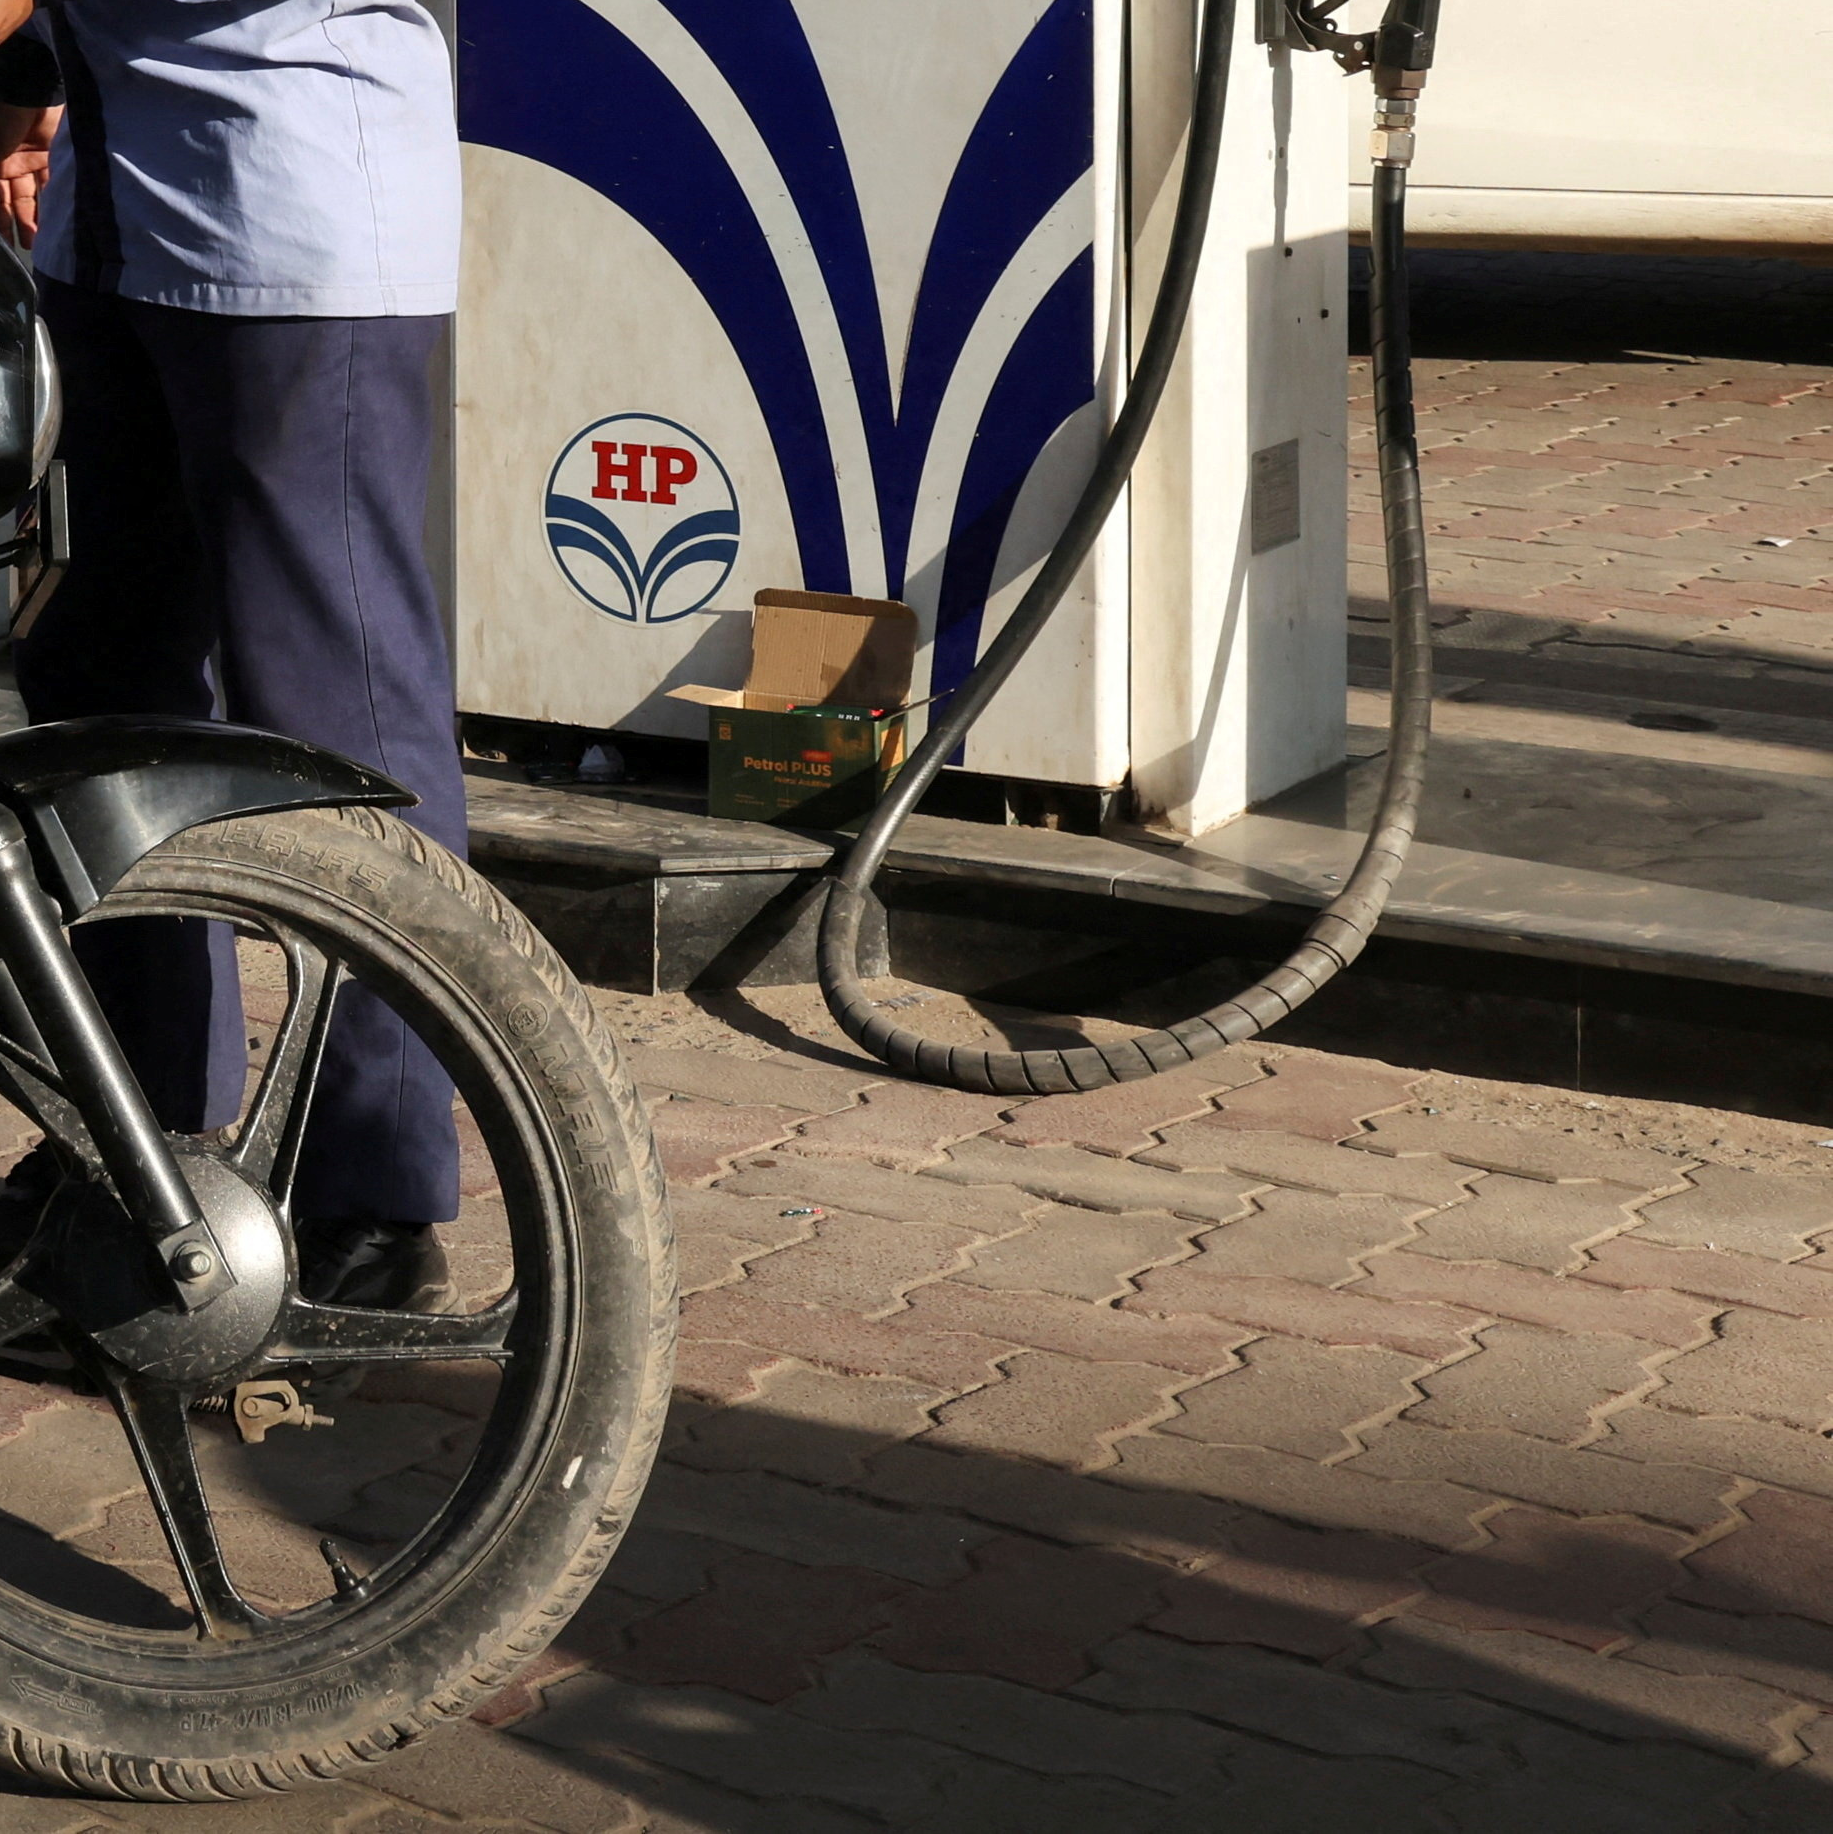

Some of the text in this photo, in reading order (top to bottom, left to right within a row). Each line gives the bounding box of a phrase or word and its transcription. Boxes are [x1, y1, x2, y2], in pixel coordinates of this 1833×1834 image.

[591, 440, 698, 506] HP
[743, 756, 789, 773] Petrol
[791, 761, 832, 777] PLUS
[530, 1042, 622, 1195] MRF
